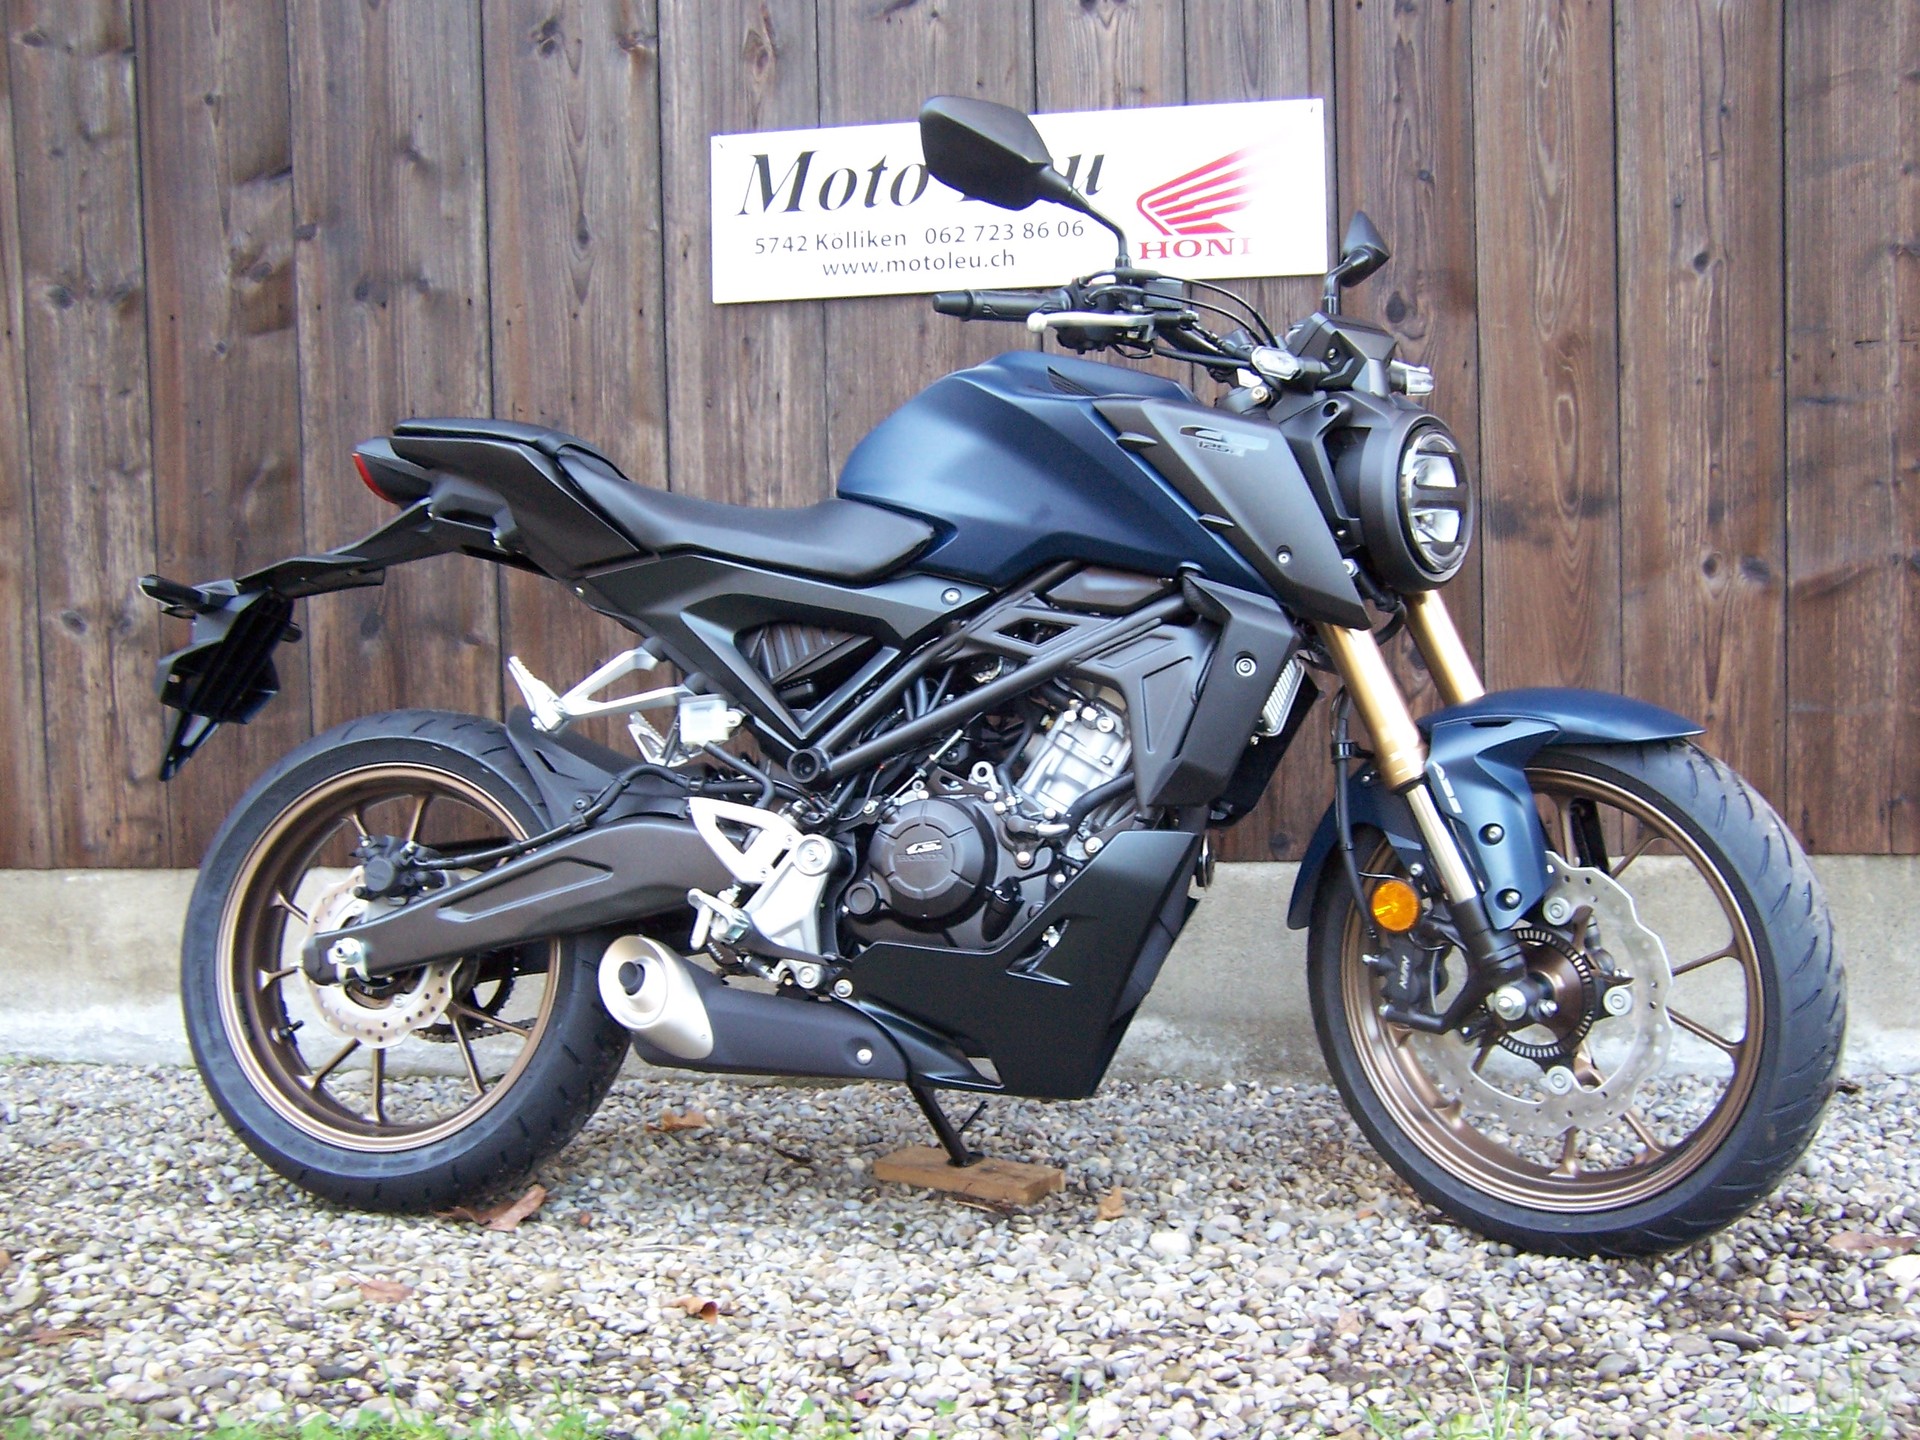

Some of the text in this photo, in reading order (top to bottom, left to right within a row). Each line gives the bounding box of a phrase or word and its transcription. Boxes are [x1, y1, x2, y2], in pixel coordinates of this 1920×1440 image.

[735, 150, 929, 215] Moto
[755, 220, 1084, 254] 5742 Kölliken 062 723 86 06
[822, 249, 1015, 276] www.motoleu.ch
